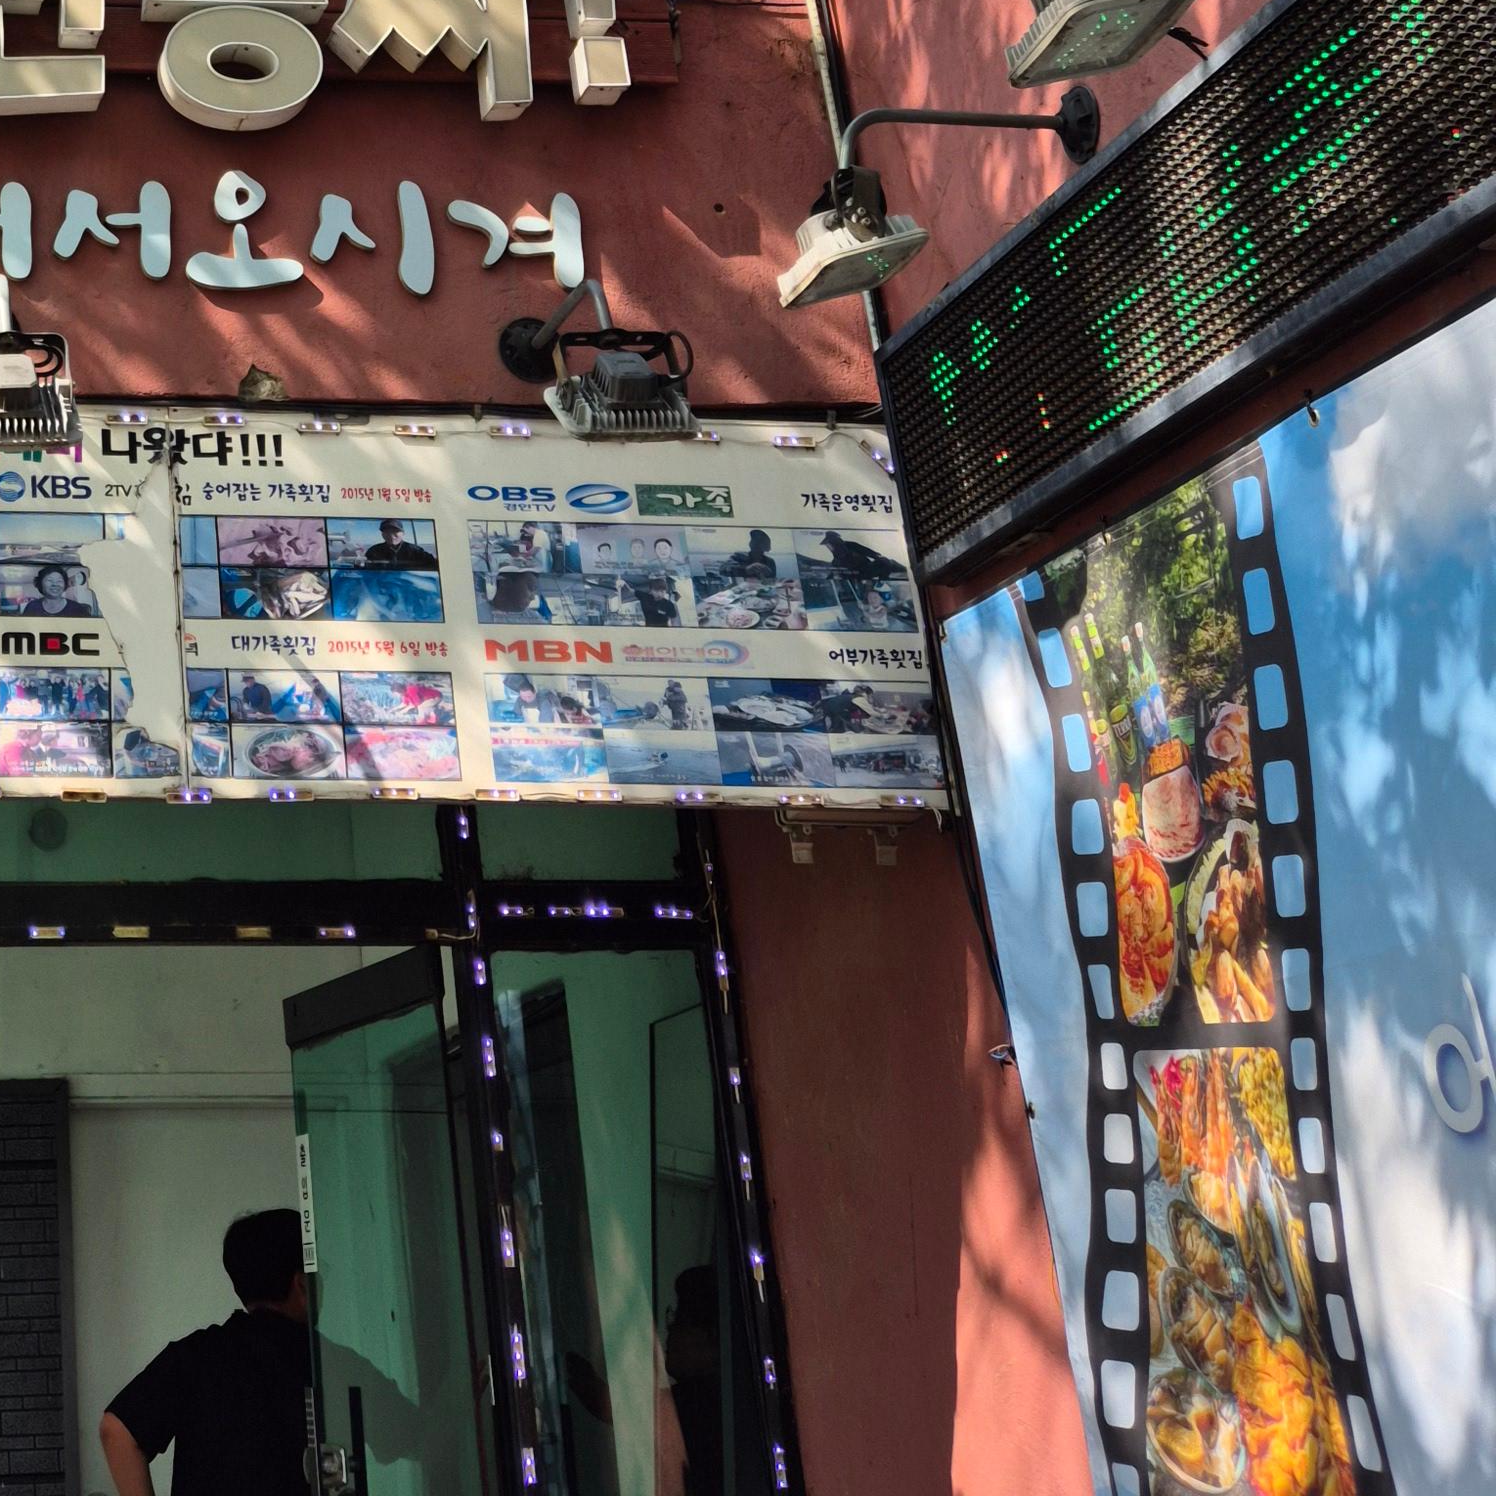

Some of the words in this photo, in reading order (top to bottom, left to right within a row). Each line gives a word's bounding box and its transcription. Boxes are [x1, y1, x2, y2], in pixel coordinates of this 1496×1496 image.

[30, 474, 93, 500] KBS
[202, 481, 262, 502] 숭어잡는
[267, 482, 331, 503] 가족횟집
[340, 487, 374, 500] 2015년
[377, 487, 392, 502] 1월
[394, 488, 411, 504] 5일
[413, 488, 433, 504] 방송
[466, 485, 557, 503] OBS
[655, 485, 731, 514] 가족
[800, 492, 894, 514] 가족운영횟집
[230, 634, 317, 656] 대가족횟집
[327, 639, 371, 655] 2015년
[374, 639, 395, 656] 5월
[399, 640, 421, 657] 6일
[424, 641, 449, 658] 방송
[484, 639, 614, 664] MBN
[828, 648, 924, 670] 어부가족횟집
